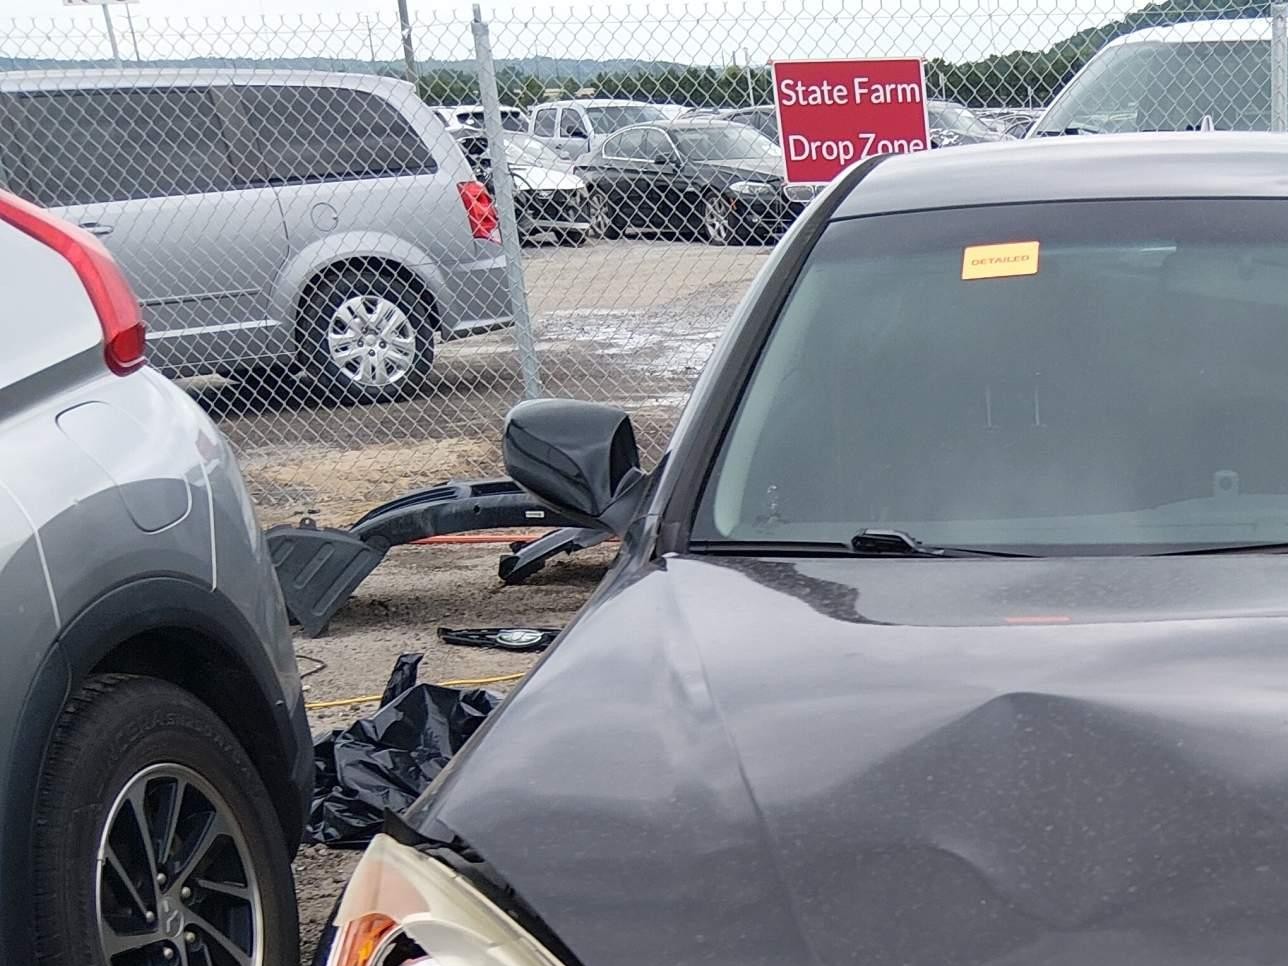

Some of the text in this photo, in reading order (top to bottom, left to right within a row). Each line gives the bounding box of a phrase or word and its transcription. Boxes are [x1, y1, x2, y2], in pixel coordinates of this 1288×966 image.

[780, 77, 921, 106] State Farm
[788, 133, 924, 164] Drop Zone
[971, 255, 1030, 266] DETAILED
